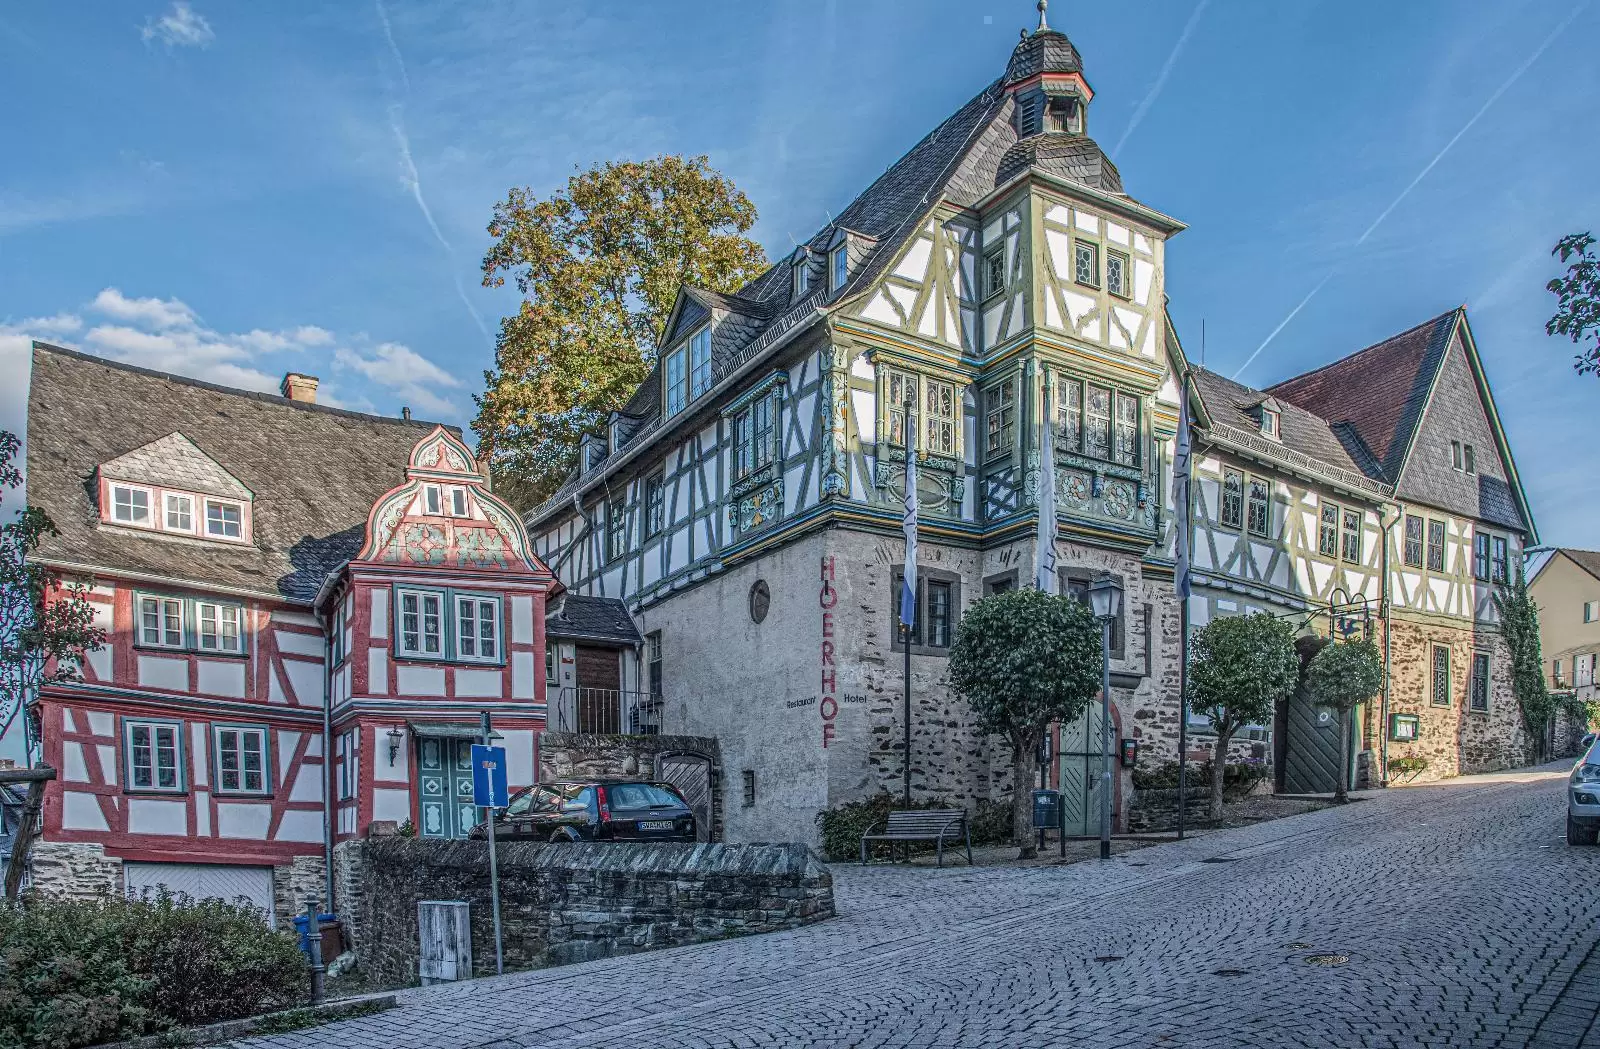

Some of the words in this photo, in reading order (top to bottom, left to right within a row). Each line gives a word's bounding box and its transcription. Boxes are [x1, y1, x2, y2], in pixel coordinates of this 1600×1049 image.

[819, 556, 838, 748] HOERHOF
[787, 696, 816, 709] Restaurant
[844, 694, 867, 703] Hotel
